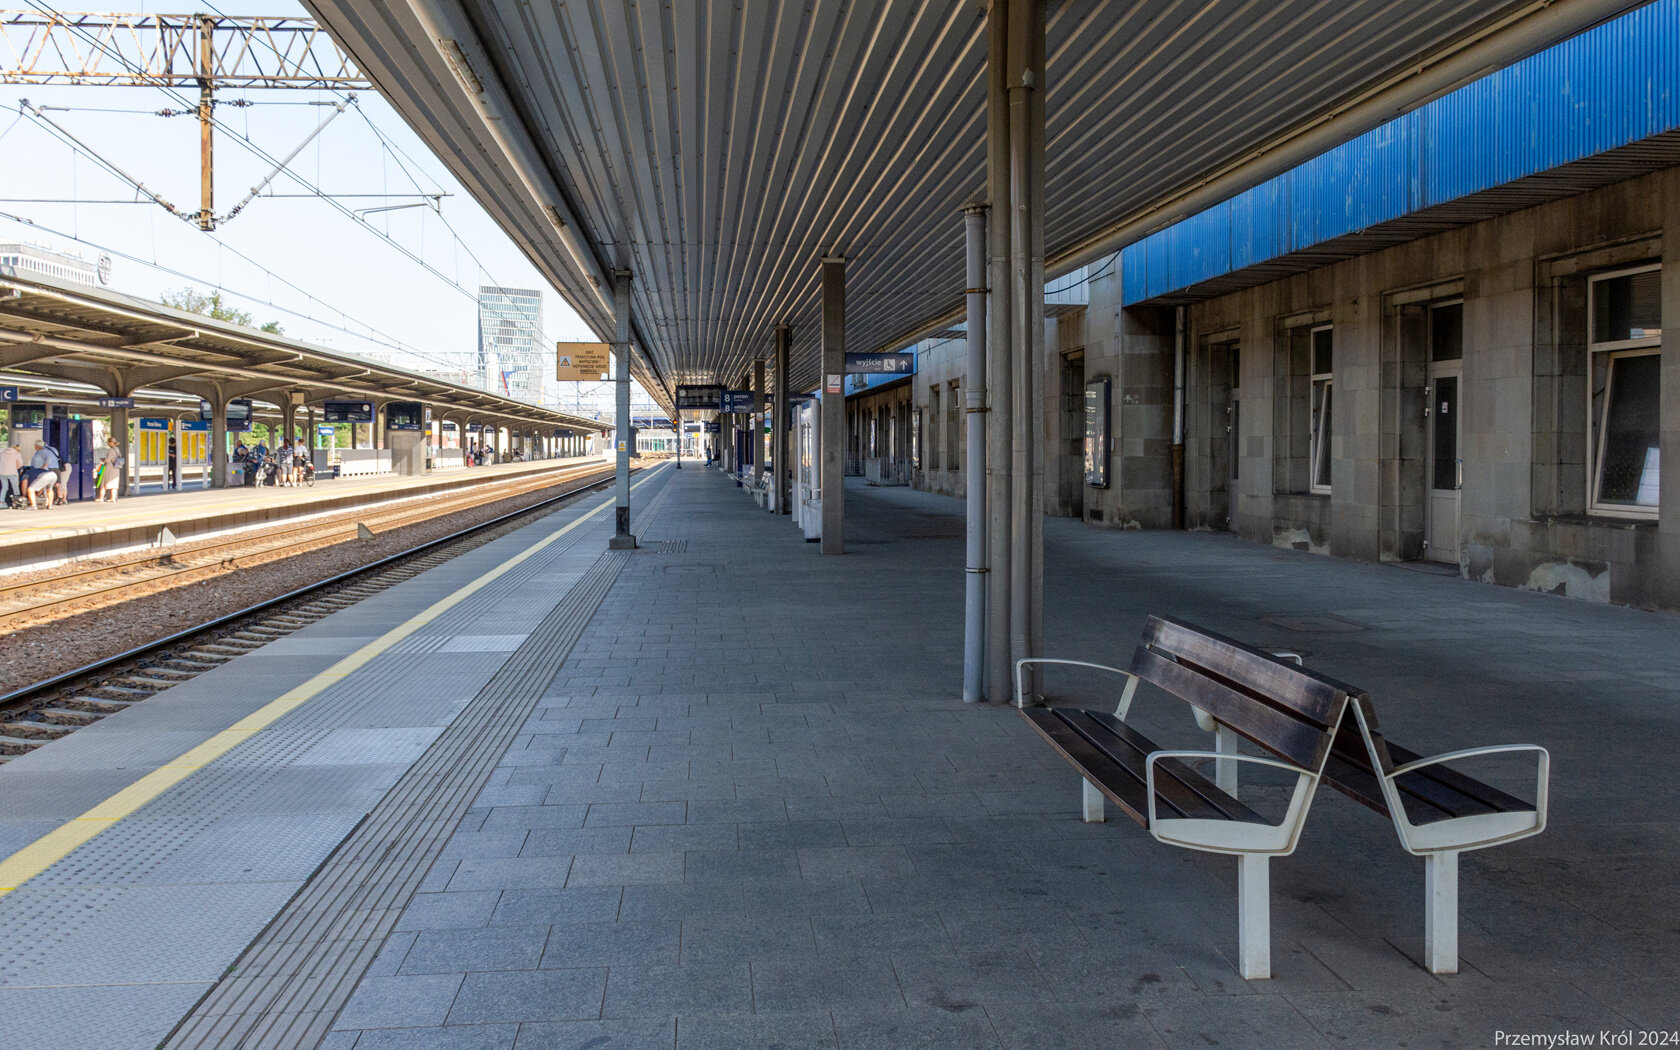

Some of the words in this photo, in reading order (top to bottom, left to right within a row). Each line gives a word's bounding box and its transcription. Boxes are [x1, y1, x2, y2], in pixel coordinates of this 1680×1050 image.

[856, 358, 882, 367] wyjście
[4, 390, 12, 399] C
[724, 394, 730, 402] 8
